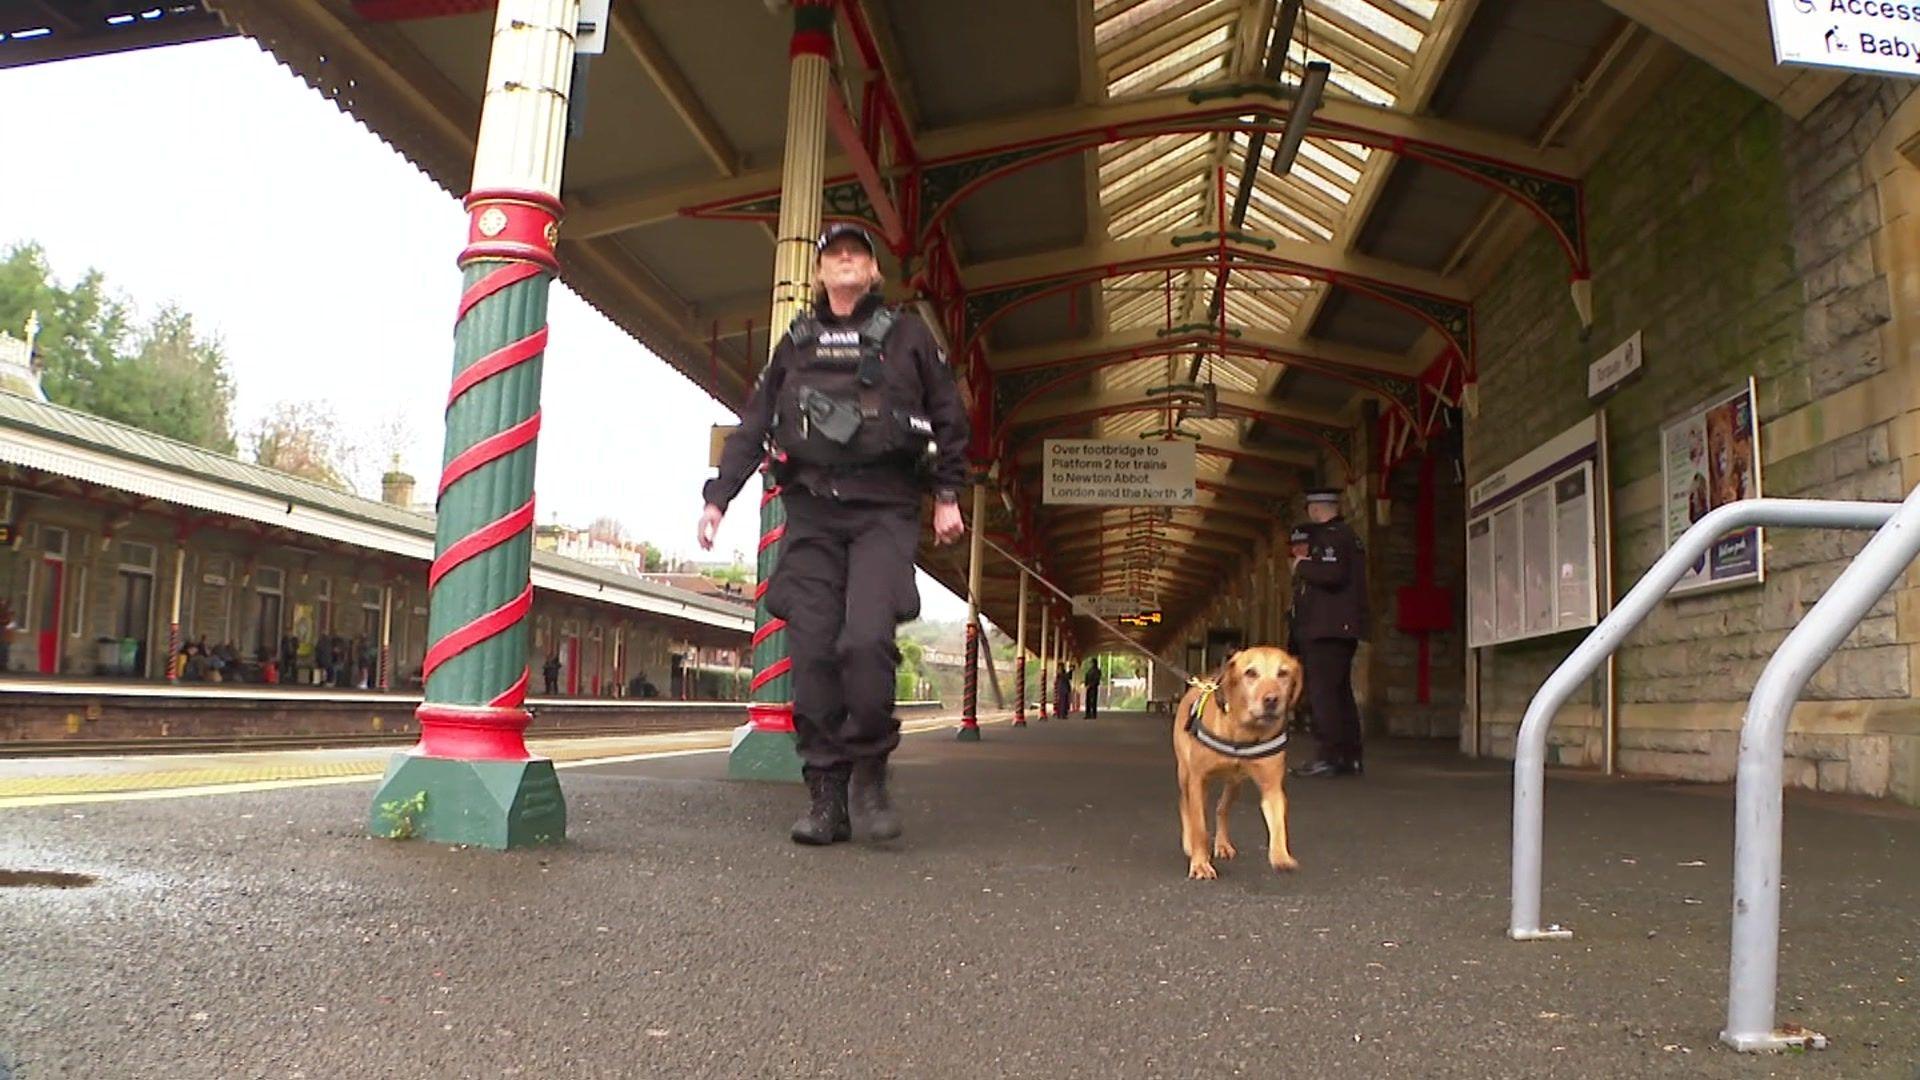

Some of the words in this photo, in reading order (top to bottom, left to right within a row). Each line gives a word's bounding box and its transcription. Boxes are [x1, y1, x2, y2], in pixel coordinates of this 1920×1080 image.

[1860, 32, 1920, 64] Baby
[1052, 444, 1080, 455] Over
[1083, 444, 1144, 457] footbridge
[1147, 445, 1159, 455] to
[1052, 459, 1102, 469] Platform
[1104, 460, 1112, 470] 2
[1114, 460, 1130, 470] for
[1133, 460, 1167, 470] trains
[1052, 473, 1065, 482] to
[1066, 473, 1111, 483] Newton
[1114, 473, 1149, 483] Abbot
[1051, 487, 1095, 498] London
[1097, 488, 1119, 498] and
[1122, 487, 1141, 498] the
[1143, 488, 1177, 498] North
